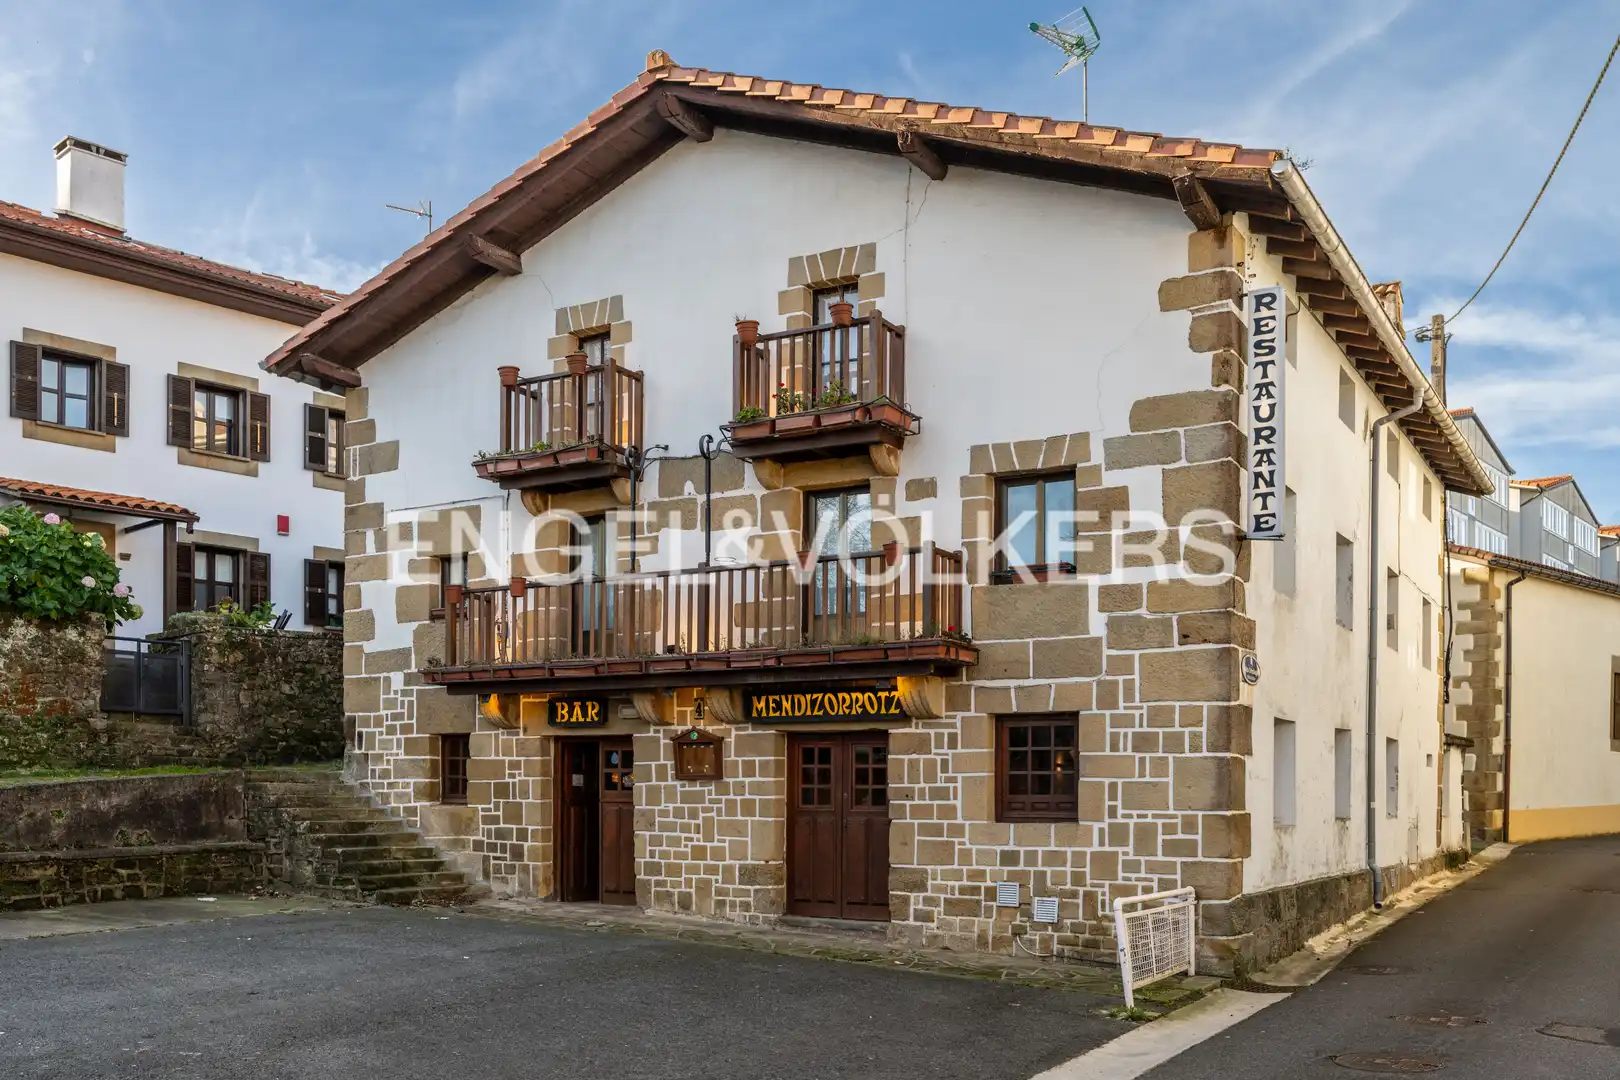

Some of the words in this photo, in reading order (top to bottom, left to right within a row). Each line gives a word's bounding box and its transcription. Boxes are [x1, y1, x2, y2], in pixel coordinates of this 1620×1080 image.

[1252, 292, 1277, 533] RESTAURANTE
[555, 701, 600, 723] BAR
[695, 701, 703, 717] 4
[751, 690, 901, 718] MENDIZORROTZ
